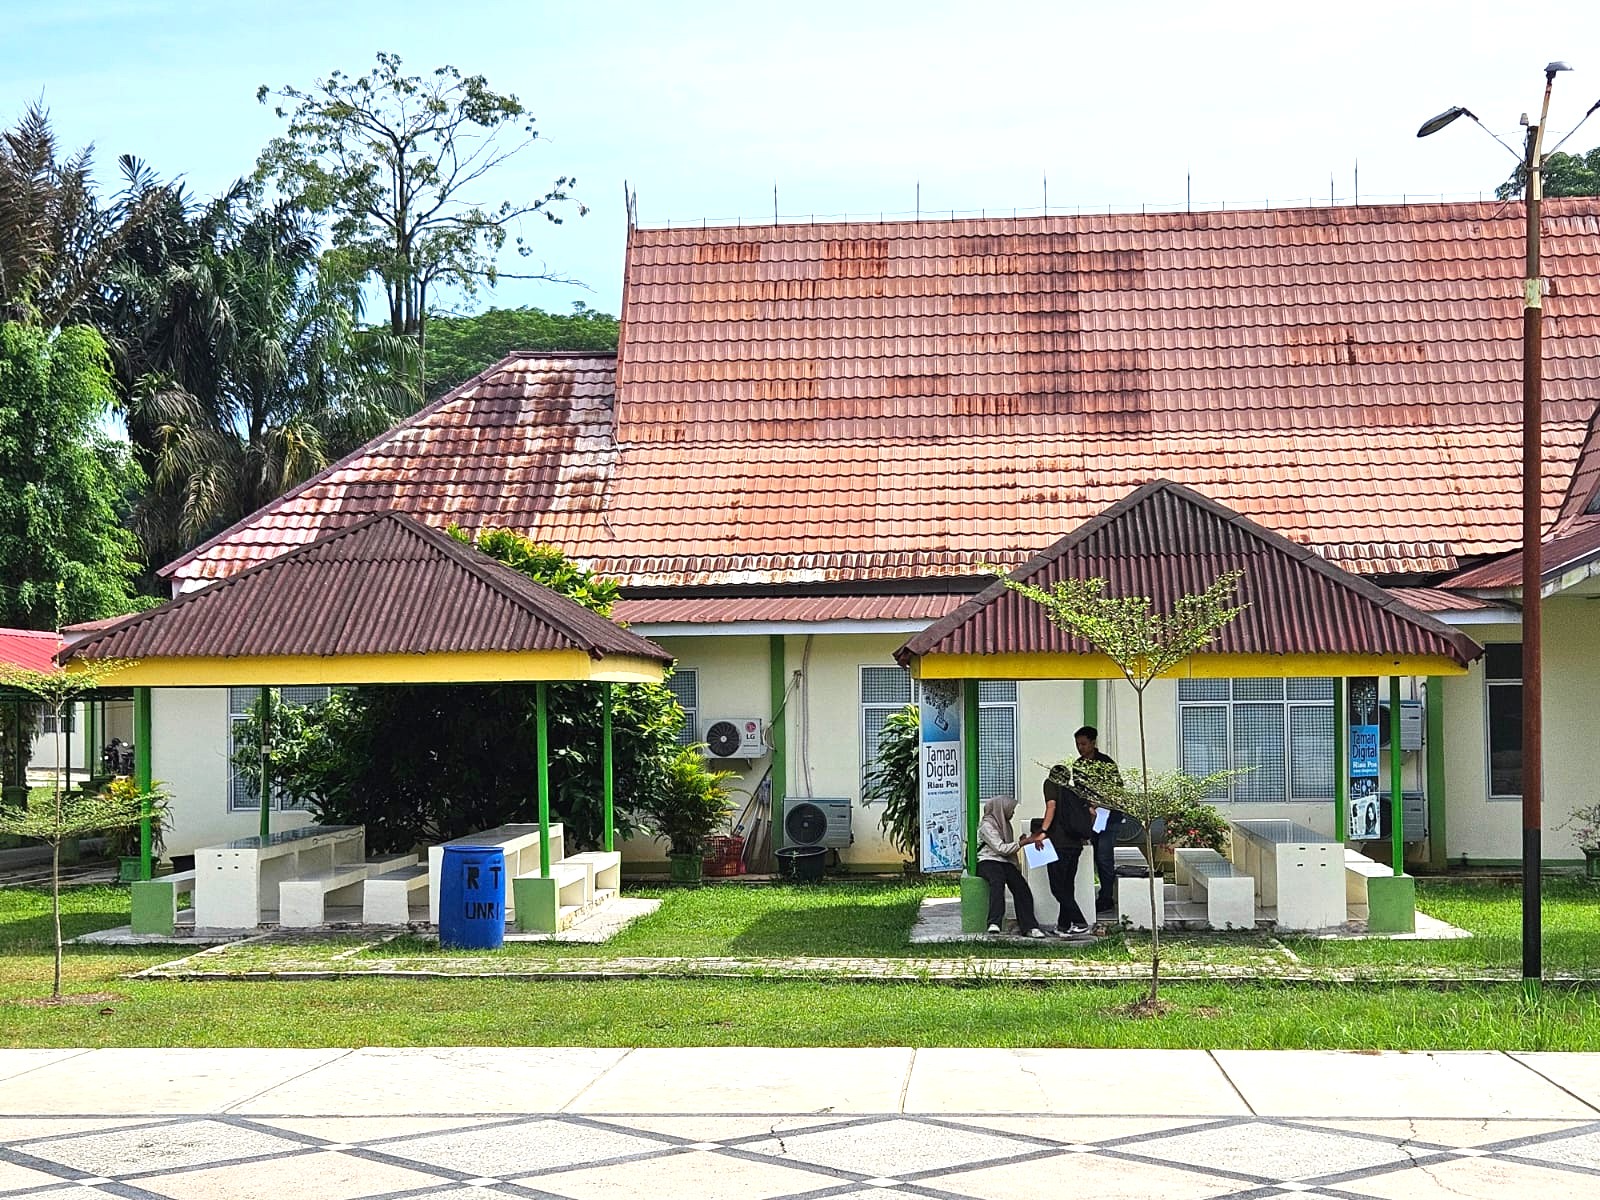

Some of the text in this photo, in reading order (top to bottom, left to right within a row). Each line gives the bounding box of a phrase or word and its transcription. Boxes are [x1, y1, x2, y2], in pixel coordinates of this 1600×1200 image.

[1352, 731, 1376, 744] Taman
[926, 746, 957, 761] Taman
[1352, 744, 1377, 761] Digital
[926, 760, 958, 781] Digital
[927, 780, 958, 790] Riau Pos
[465, 902, 499, 920] UNRI
